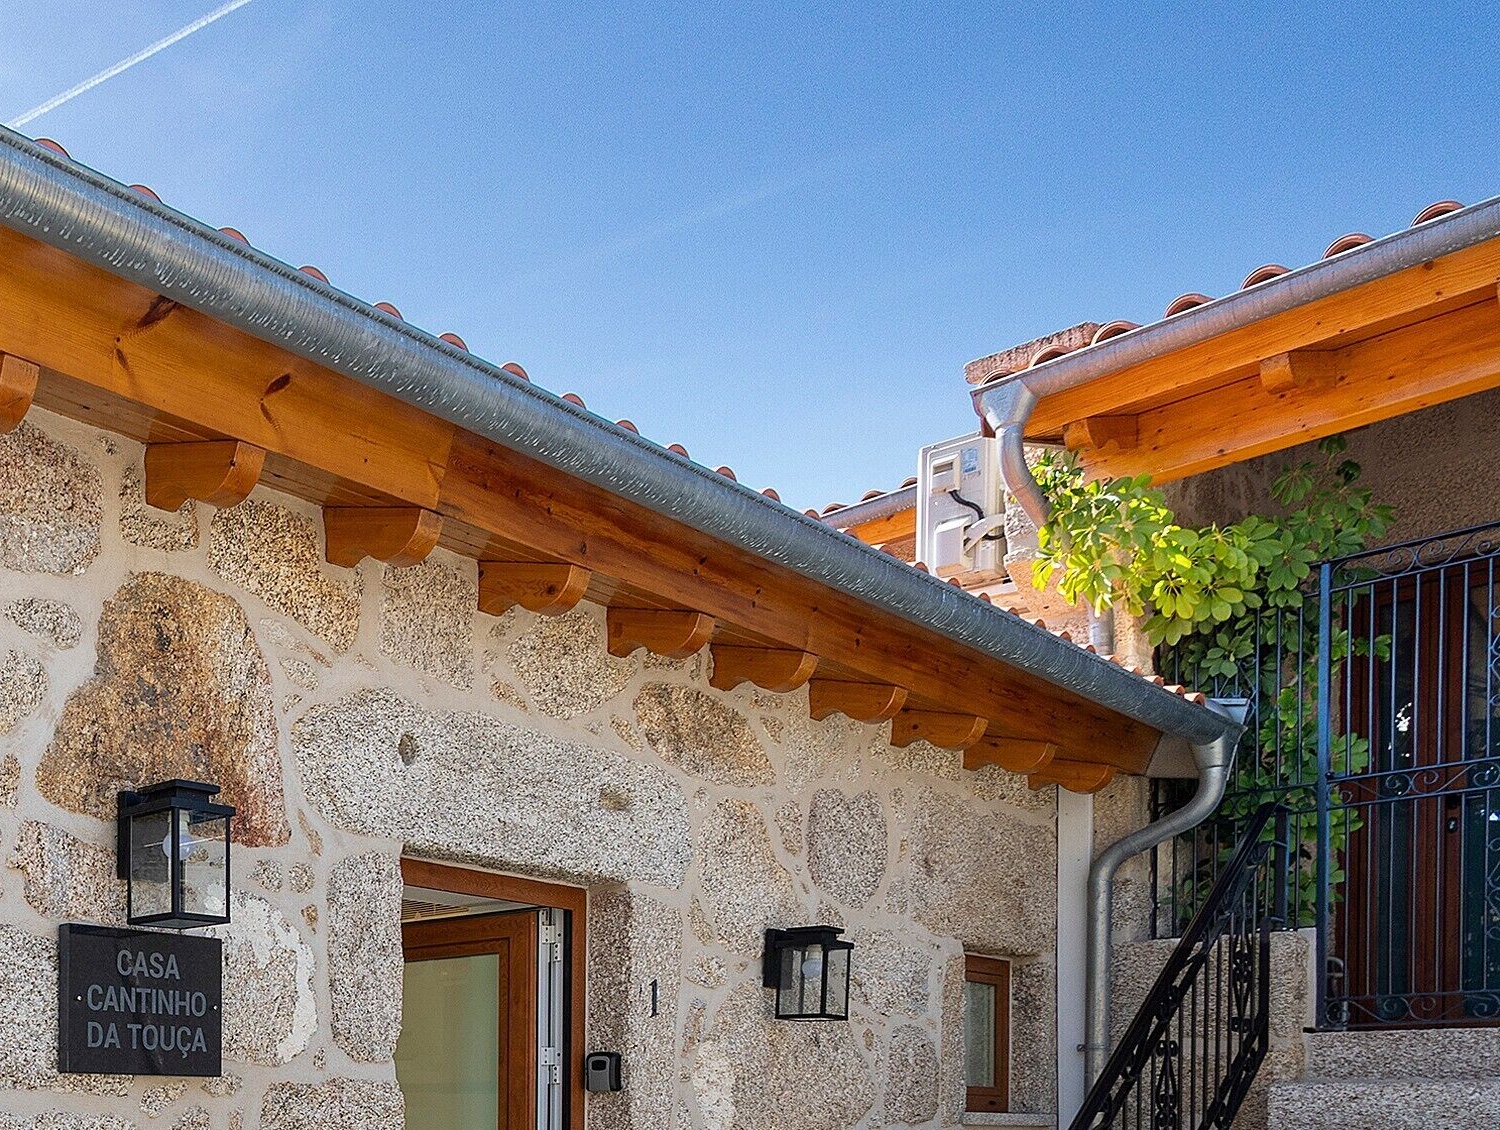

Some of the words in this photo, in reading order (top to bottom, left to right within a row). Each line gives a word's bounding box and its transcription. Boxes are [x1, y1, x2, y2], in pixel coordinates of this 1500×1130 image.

[116, 949, 181, 980] CASA
[86, 984, 207, 1017] CANTINHO
[649, 979, 660, 1018] 1
[86, 1021, 121, 1049] DA
[127, 1023, 208, 1058] TOUÇA
